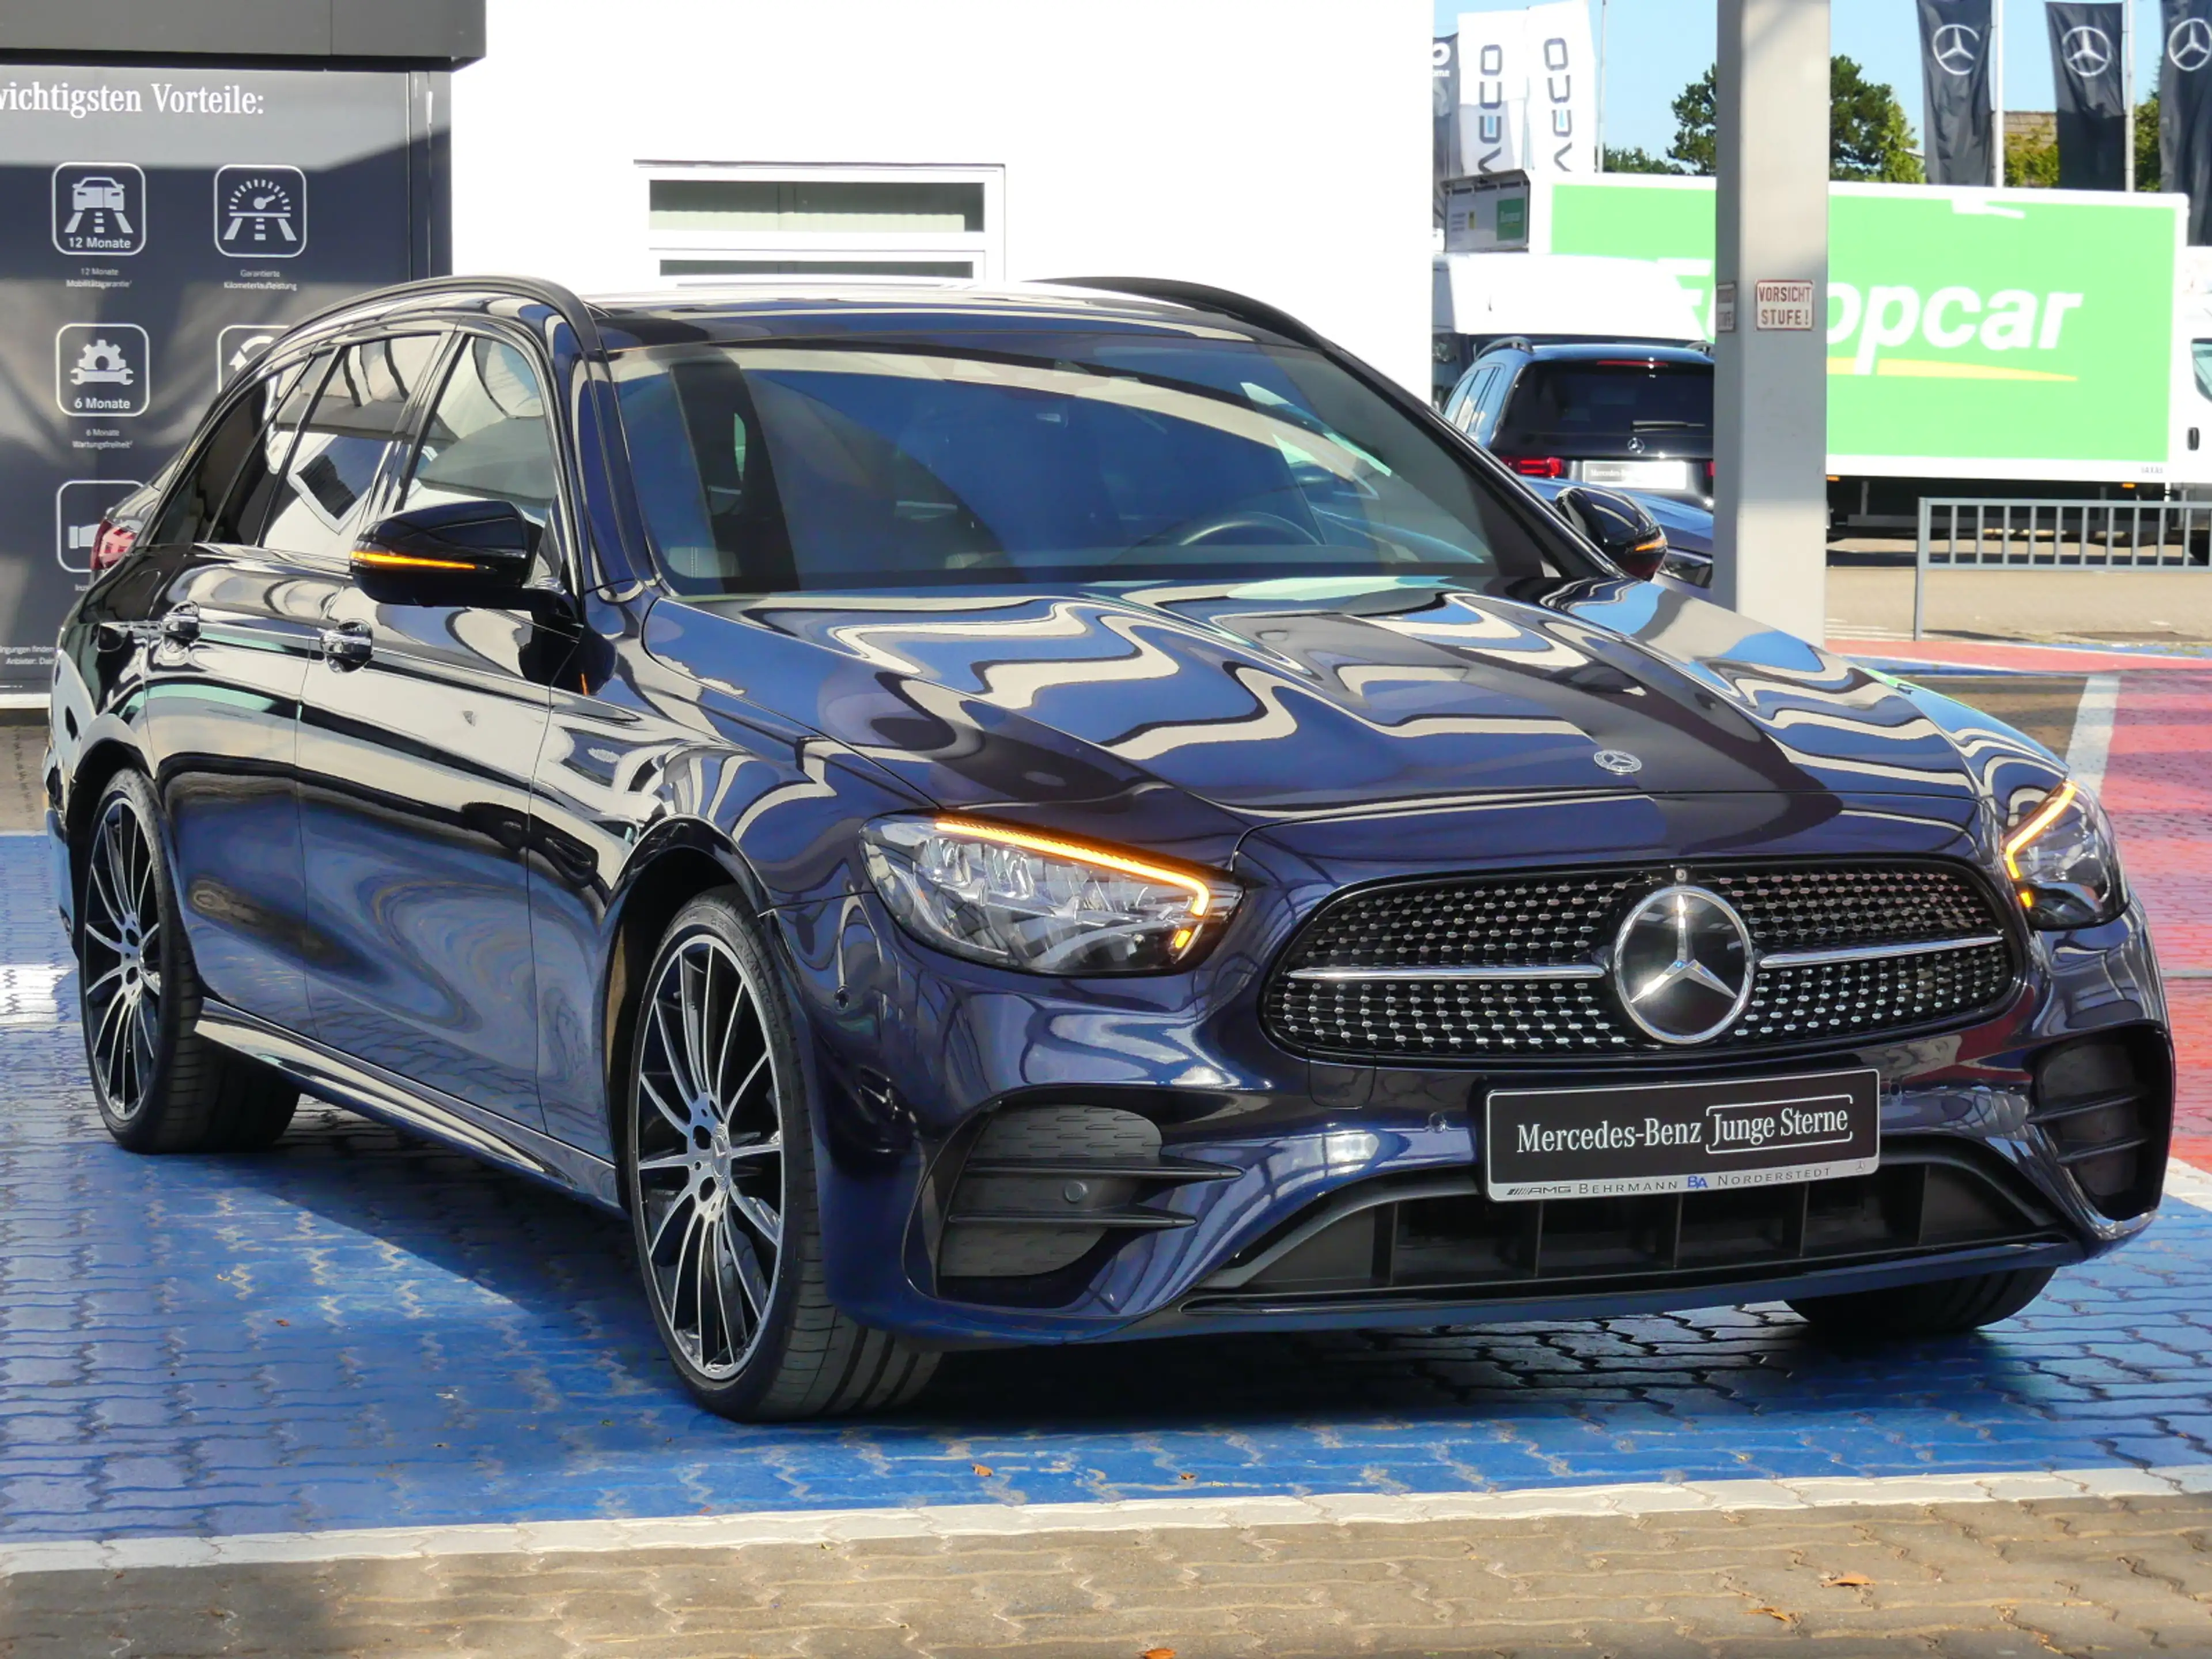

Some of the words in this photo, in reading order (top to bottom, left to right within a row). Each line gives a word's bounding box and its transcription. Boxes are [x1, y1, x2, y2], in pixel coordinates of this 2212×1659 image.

[150, 83, 264, 114] Vorteile:
[68, 237, 83, 248] 12
[86, 236, 131, 249] Monate
[81, 267, 89, 276] 12
[91, 267, 119, 276] Monate
[1758, 286, 1812, 303] VORSICHT
[74, 397, 82, 410] 6
[85, 397, 131, 410] Monate
[92, 428, 120, 437] Monate
[1516, 1118, 1702, 1153] Mercedes-Benz
[1711, 1113, 1775, 1146] Junge
[1780, 1107, 1849, 1137] Sterne
[1578, 1181, 1678, 1195] BEHRMANN
[1717, 1167, 1831, 1187] NORDERSTEDT
